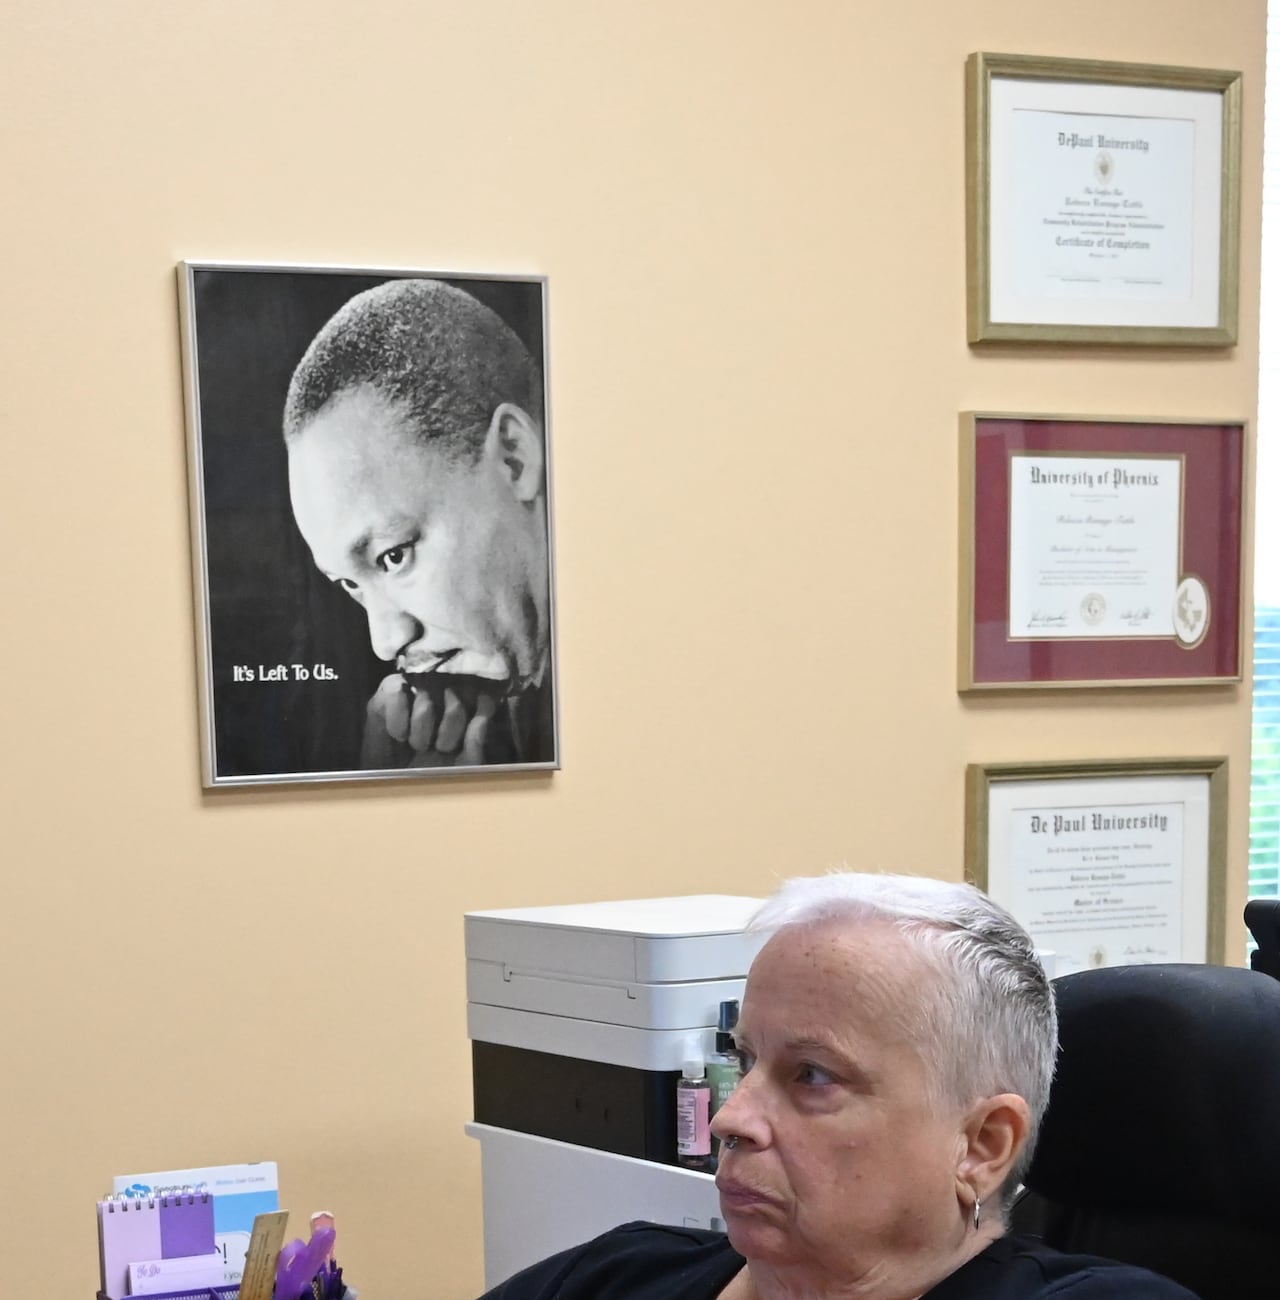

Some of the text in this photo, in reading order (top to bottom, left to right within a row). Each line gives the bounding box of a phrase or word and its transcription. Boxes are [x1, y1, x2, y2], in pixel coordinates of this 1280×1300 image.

[1097, 134, 1150, 153] University
[1031, 465, 1159, 490] University of Phoenix
[233, 663, 339, 681] It's Left To Us.
[1031, 812, 1169, 837] De Paul University
